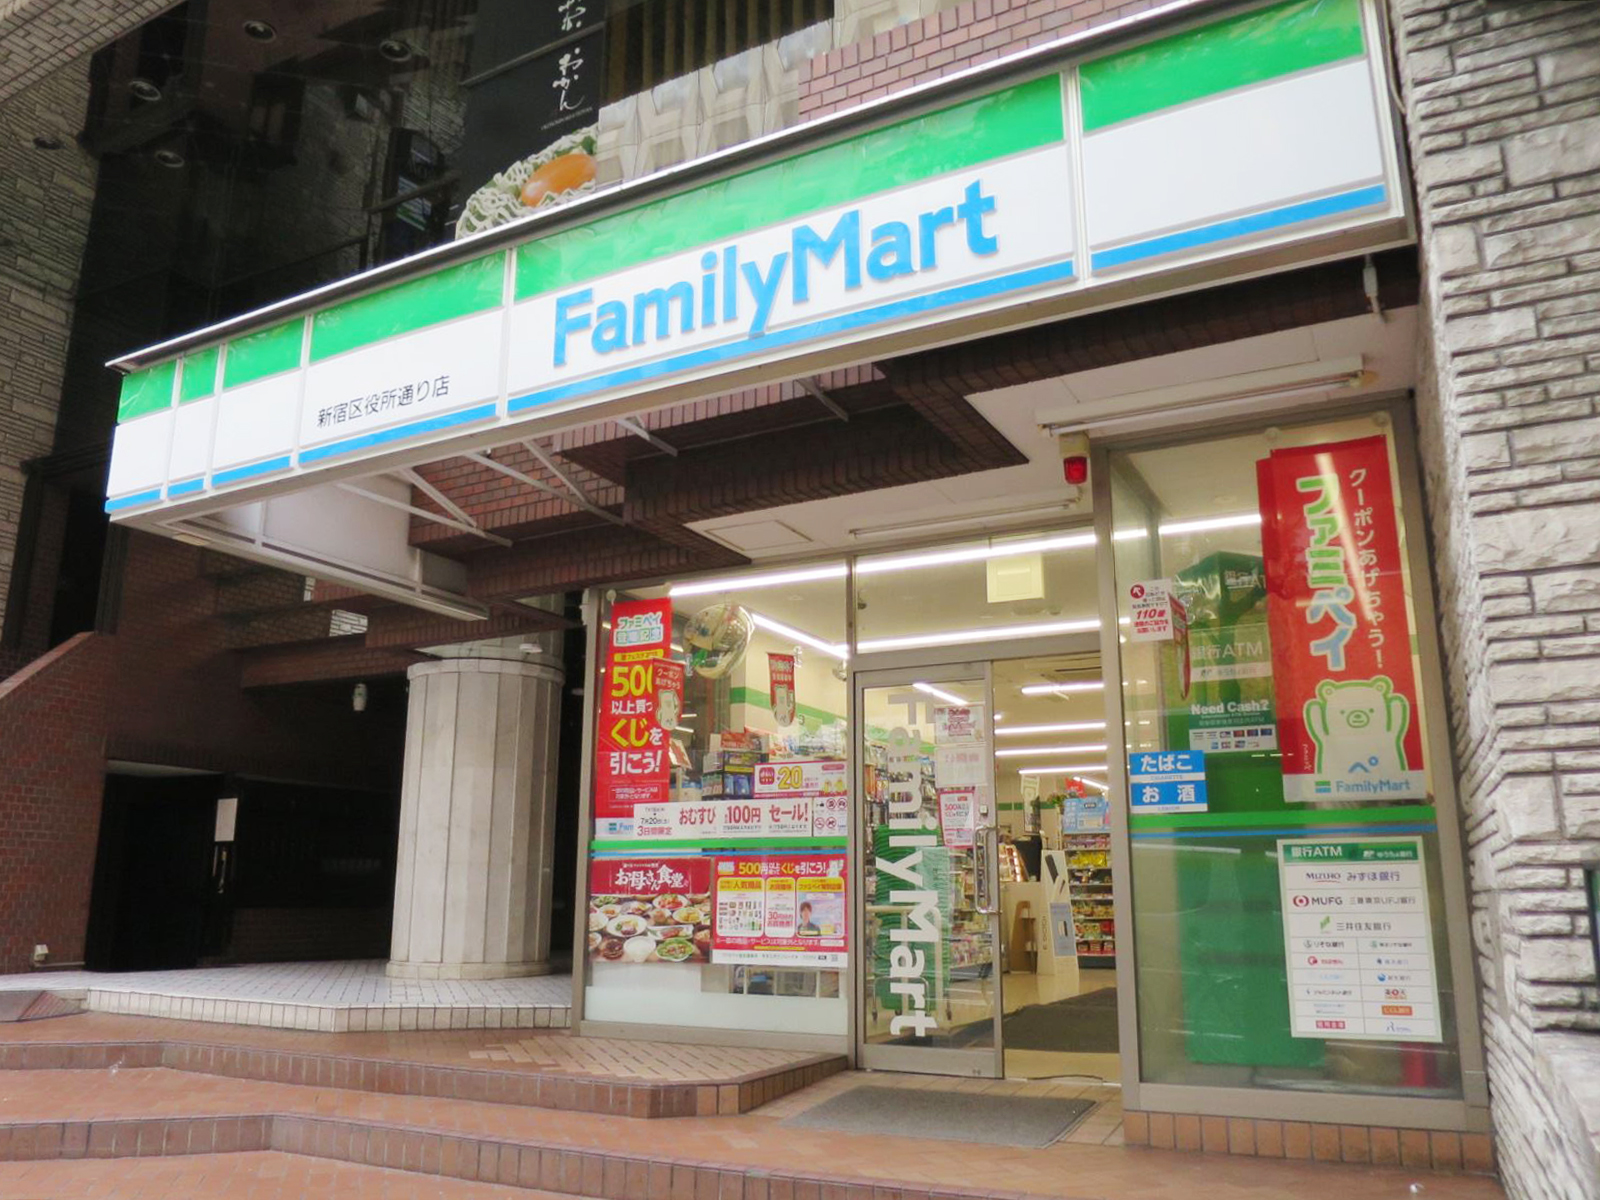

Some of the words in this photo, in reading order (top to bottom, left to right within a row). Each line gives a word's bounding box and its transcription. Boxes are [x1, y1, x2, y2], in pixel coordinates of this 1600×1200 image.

[553, 178, 999, 368] FamilyMart
[317, 375, 450, 428] 新宿区役所通り店
[1296, 473, 1357, 672] ファミペイ
[617, 611, 663, 630] ファミペイ
[1191, 702, 1225, 715] Need
[611, 718, 663, 747] くじを
[610, 750, 663, 775] 引こう!
[1140, 754, 1193, 772] たばこ
[1335, 778, 1411, 793] FamilyMart
[679, 806, 716, 826] おむすび
[769, 803, 808, 823] セール!
[1291, 845, 1343, 859] 銀行ATM
[614, 864, 685, 891] お母さん食堂
[1305, 872, 1342, 880] MIZUHO
[1346, 871, 1401, 882] みずほ銀行
[1311, 896, 1344, 906] MUFG
[1336, 921, 1392, 931] 三井住友銀行
